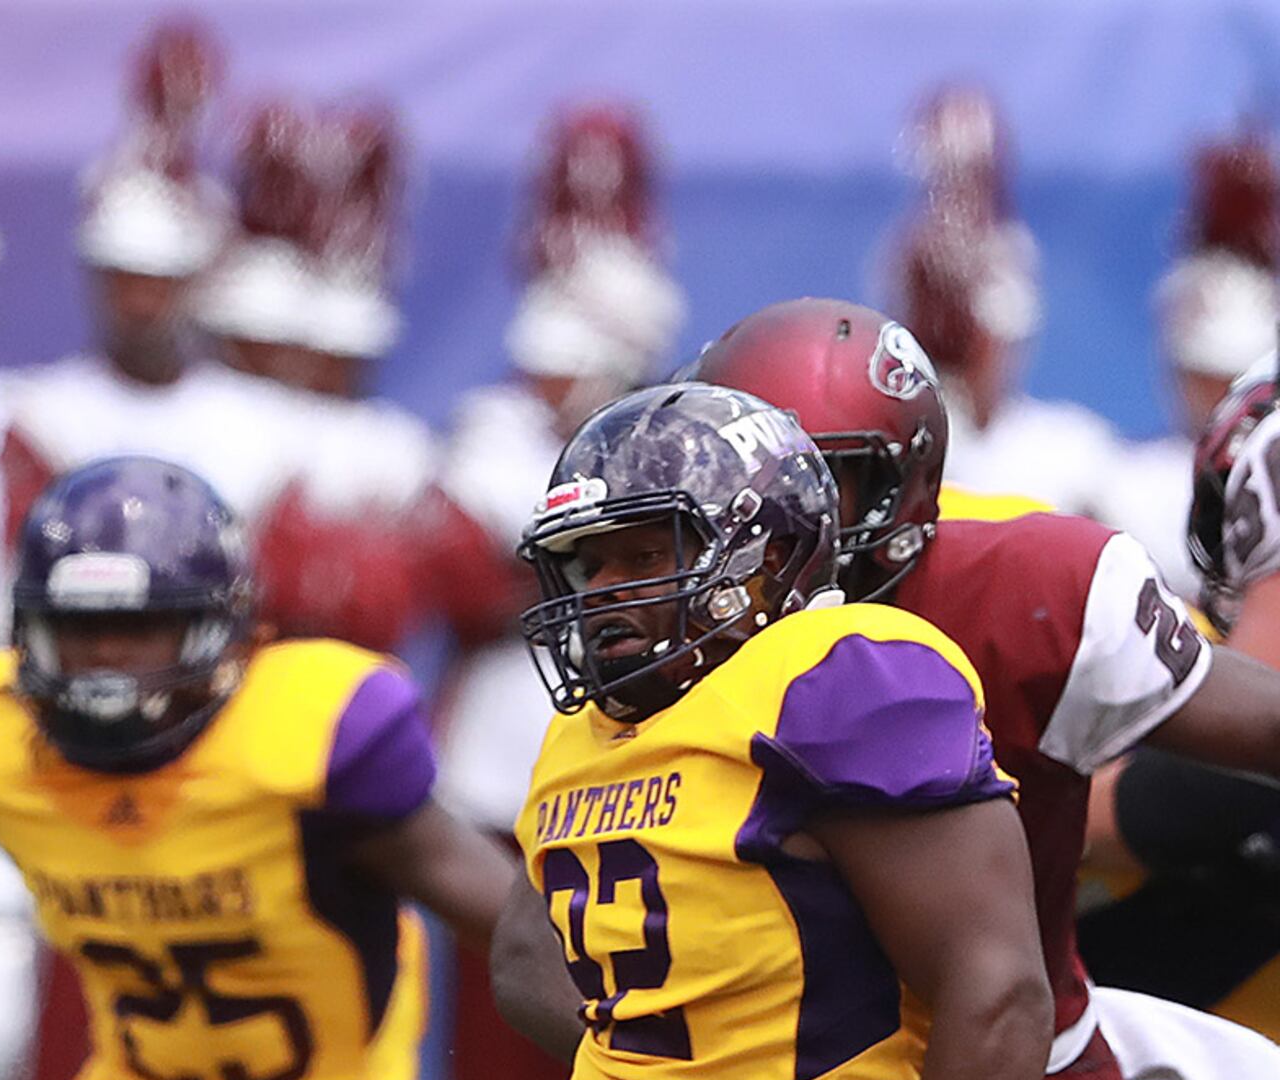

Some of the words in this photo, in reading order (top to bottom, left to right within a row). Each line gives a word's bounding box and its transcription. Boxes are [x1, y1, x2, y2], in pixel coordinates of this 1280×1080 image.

[1135, 577, 1203, 690] 2
[537, 772, 681, 844] PANTHERS
[543, 838, 694, 1061] 92
